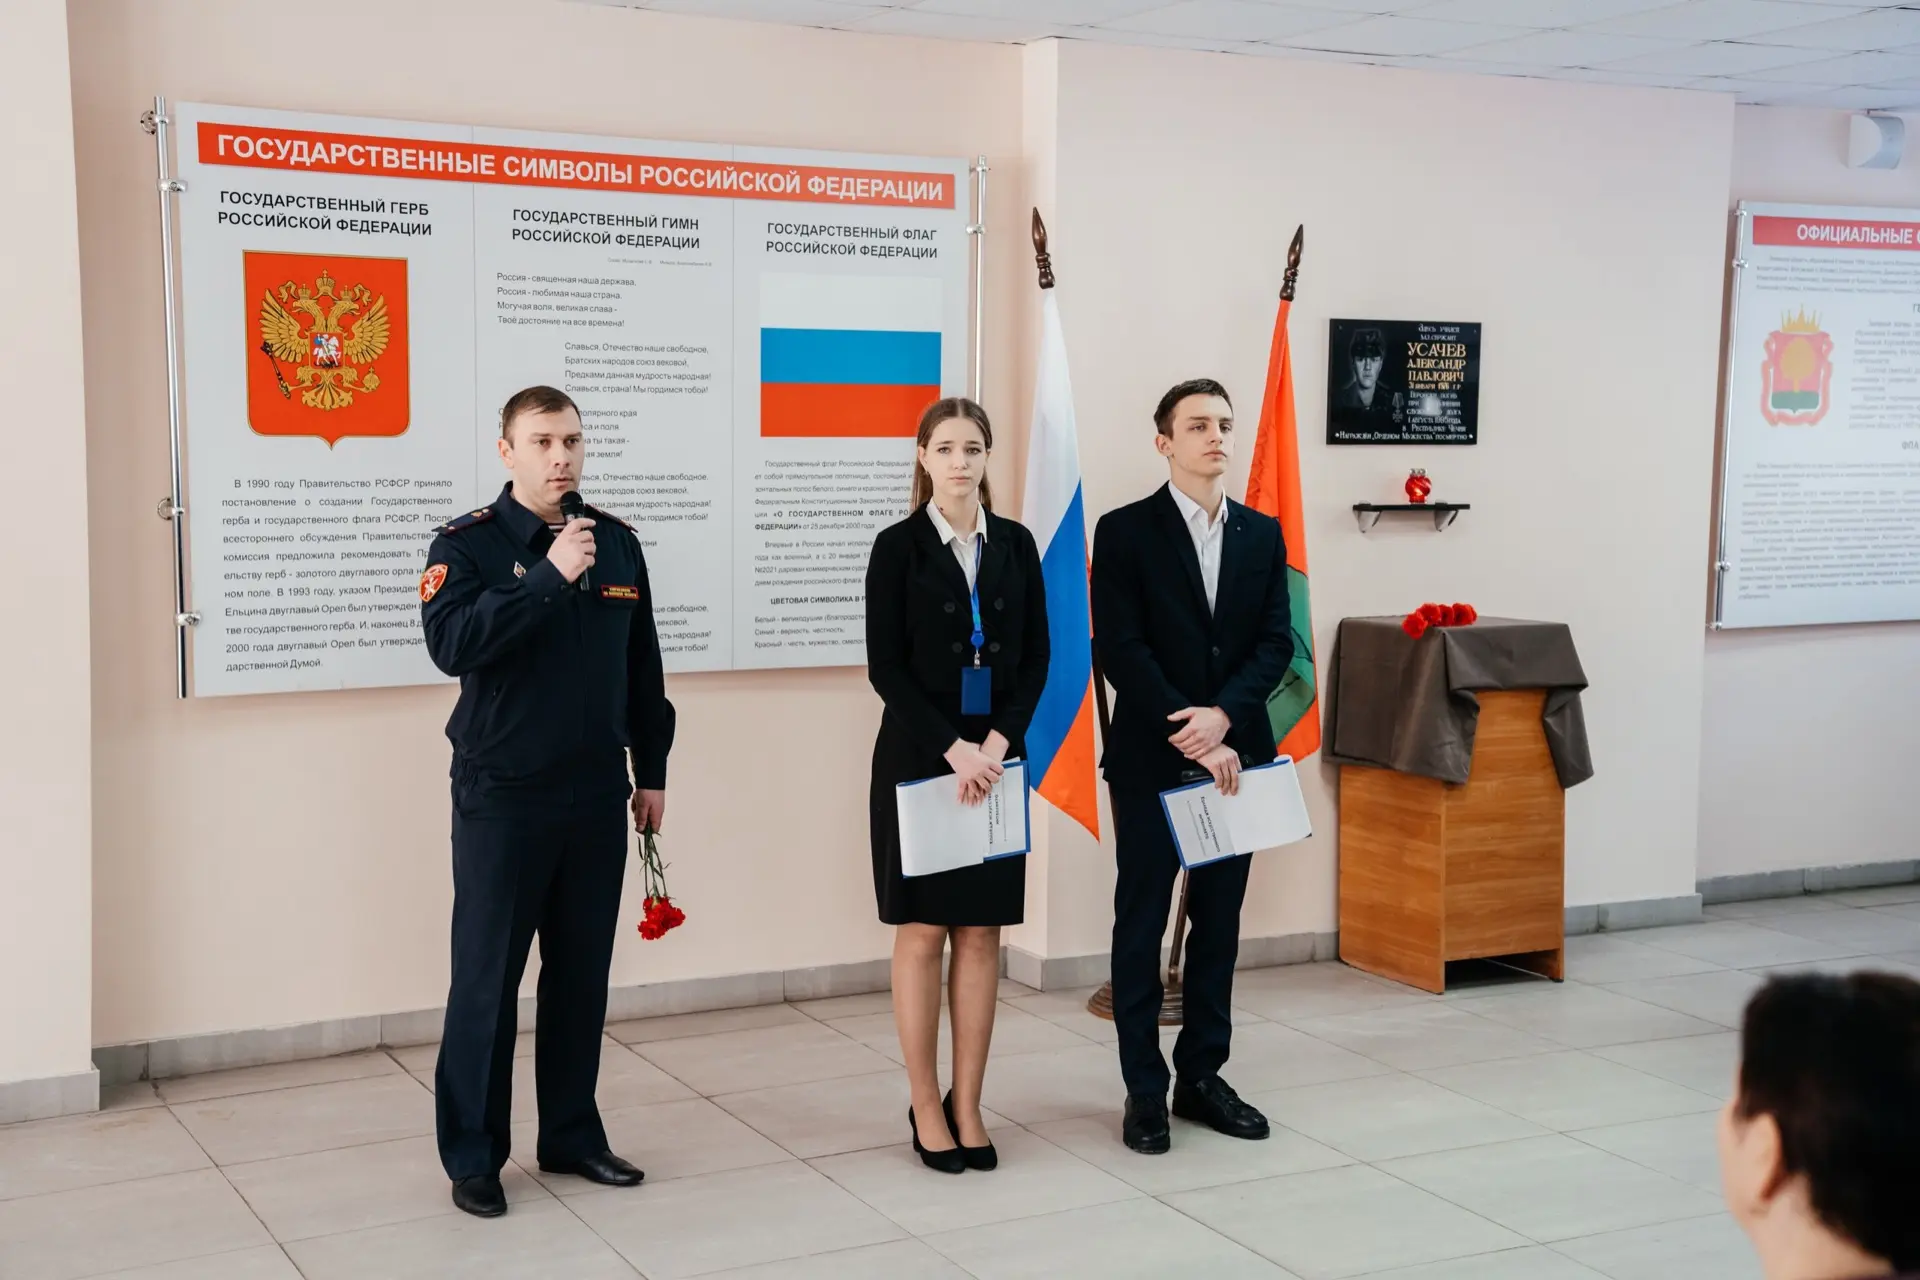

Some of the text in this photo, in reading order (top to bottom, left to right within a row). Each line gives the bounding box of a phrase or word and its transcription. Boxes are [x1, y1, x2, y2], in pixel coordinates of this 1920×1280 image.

[217, 134, 943, 202] ГОСУДАРСТВЕННЫЕ СИМВОЛЫ РОССИЙСКОЙ ФЕДЕРАЦИИ
[220, 191, 428, 215] ГОСУДАРСТВЕННЫЙ ГЕРБ
[218, 211, 431, 236] РОССИЙСКОЙ ФЕДЕРАЦИИ
[513, 209, 698, 230] ГОСУДАРСТВЕННЫЙ ГИМН
[767, 222, 937, 240] ГОСУДАРСТВЕННЫЙ ФЛАГ
[1796, 224, 1913, 244] ОФИЦИАЛЬНЫЕ
[512, 228, 699, 249] РОССИЙСКОЙ ФЕДЕРАЦИИ
[766, 241, 937, 259] РОССИЙСКОЙ ФЕДЕРАЦИИ
[1407, 342, 1466, 357] УСАЧЕВ
[1407, 358, 1466, 370] АЛЕКСАНДР
[1408, 370, 1464, 382] ПАВЛОВИЧ
[1902, 441, 1920, 450] ФЛА
[234, 478, 452, 489] В 1990 году Правительство РСФСР приняло
[370, 496, 452, 507] Государственного
[222, 515, 249, 526] герба
[264, 516, 348, 526] государственного
[352, 515, 380, 524] флага
[223, 532, 436, 543] всестороннего обсуждения Правительствен
[276, 552, 334, 561] предложила
[340, 550, 411, 560] рекомендовать
[223, 572, 262, 581] ельству
[265, 569, 286, 580] герб
[295, 570, 336, 578] золотого
[338, 568, 389, 578] двуглавого
[391, 568, 414, 577] орла
[276, 587, 284, 597] В
[288, 587, 310, 596] 1993
[313, 588, 335, 597] году,
[338, 587, 370, 596] указом
[374, 584, 420, 595] Президен
[224, 603, 416, 616] Ельцина двуглавый Орел был утвержден
[243, 624, 328, 634] государственного
[370, 620, 408, 629] наконец
[226, 643, 249, 653] 2000
[252, 644, 274, 652] года
[276, 642, 327, 652] двуглавый
[330, 639, 355, 649] Орел
[358, 638, 377, 647] был
